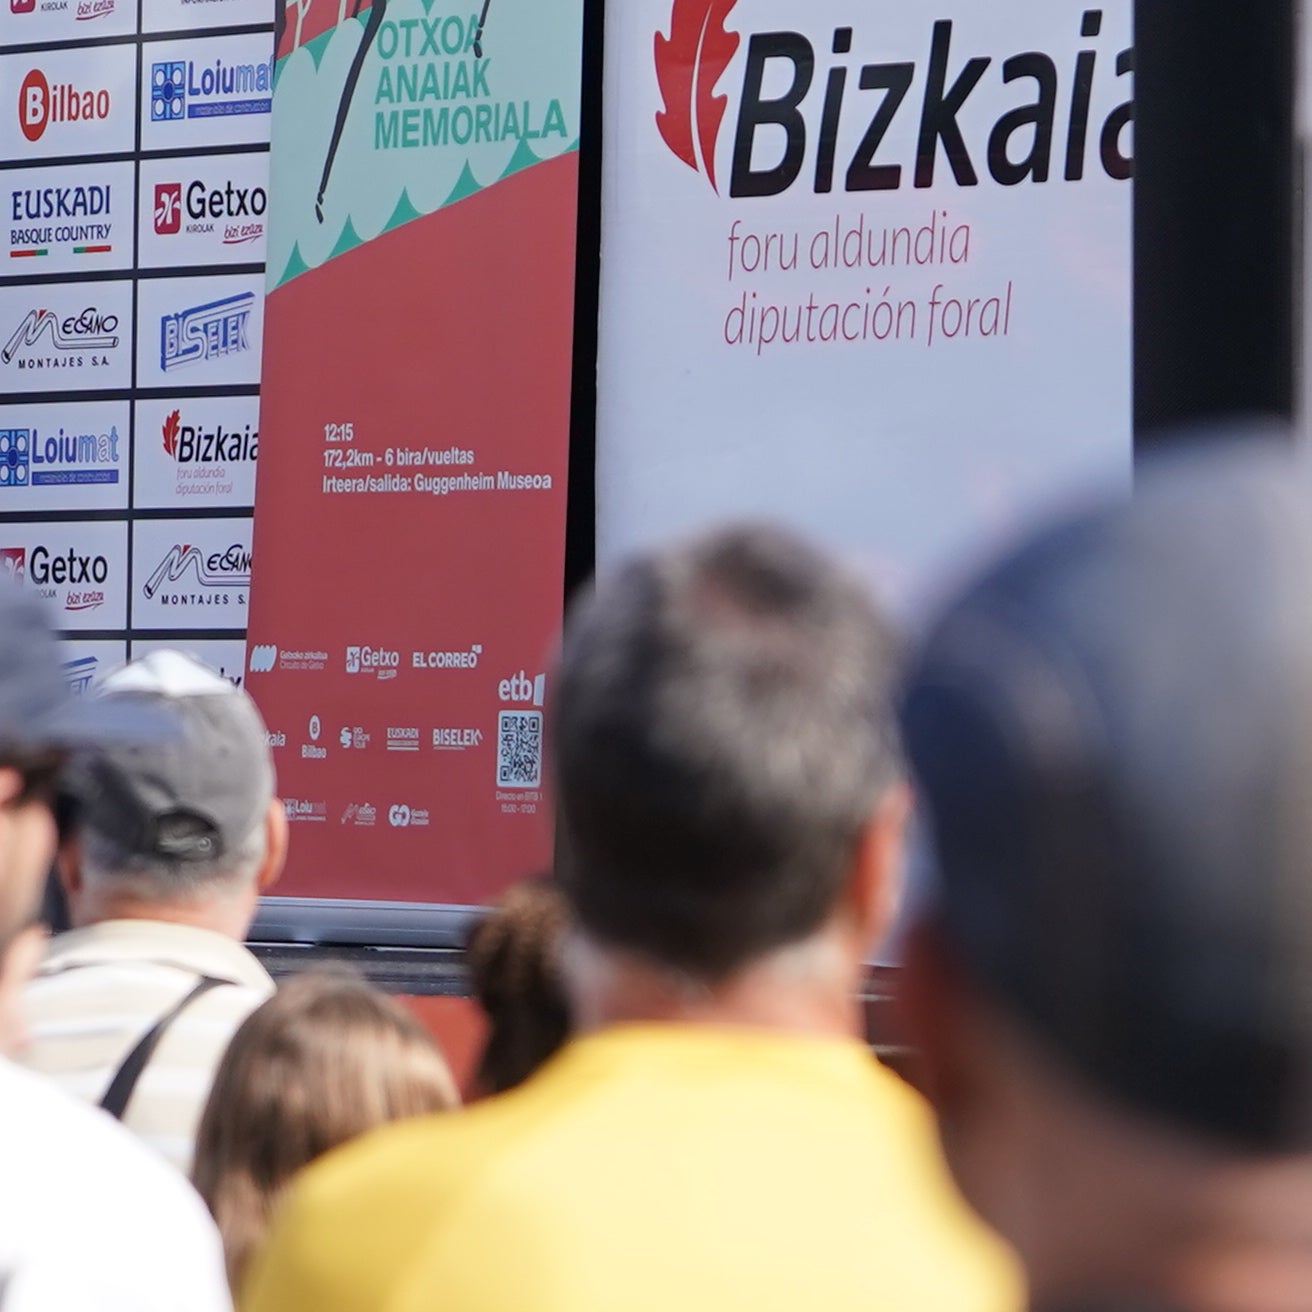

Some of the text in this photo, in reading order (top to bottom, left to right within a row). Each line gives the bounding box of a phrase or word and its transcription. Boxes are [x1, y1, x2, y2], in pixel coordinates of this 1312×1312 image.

[40, 1, 68, 12] KIROLAK
[377, 13, 483, 60] OTXOA
[375, 58, 491, 105] ANAIAK
[26, 84, 110, 126] Bilbao
[374, 99, 568, 150] MEMORIALA
[11, 185, 111, 220] EUSKADI
[186, 180, 266, 219] Getxo
[10, 223, 112, 245] BASQUE COUNTRY
[186, 223, 215, 233] KIROLAK
[727, 210, 971, 281] foru aldundia
[724, 281, 1013, 356] diputación foral
[18, 356, 84, 369] MONTAJES
[324, 423, 353, 442] 12:15
[32, 425, 119, 464] Loiumat
[323, 449, 374, 470] 172,2km
[385, 448, 394, 466] 6
[396, 447, 474, 466] bira/vueltas
[322, 471, 552, 495] Irteera/salida: Guggenheim Museoa
[29, 545, 108, 584] Getxo
[161, 594, 229, 606] MONTAJES
[360, 645, 400, 667] Getxo
[412, 651, 477, 668] EL CORREO
[432, 729, 478, 746] BISELEK
[301, 745, 327, 759] Bilbao
